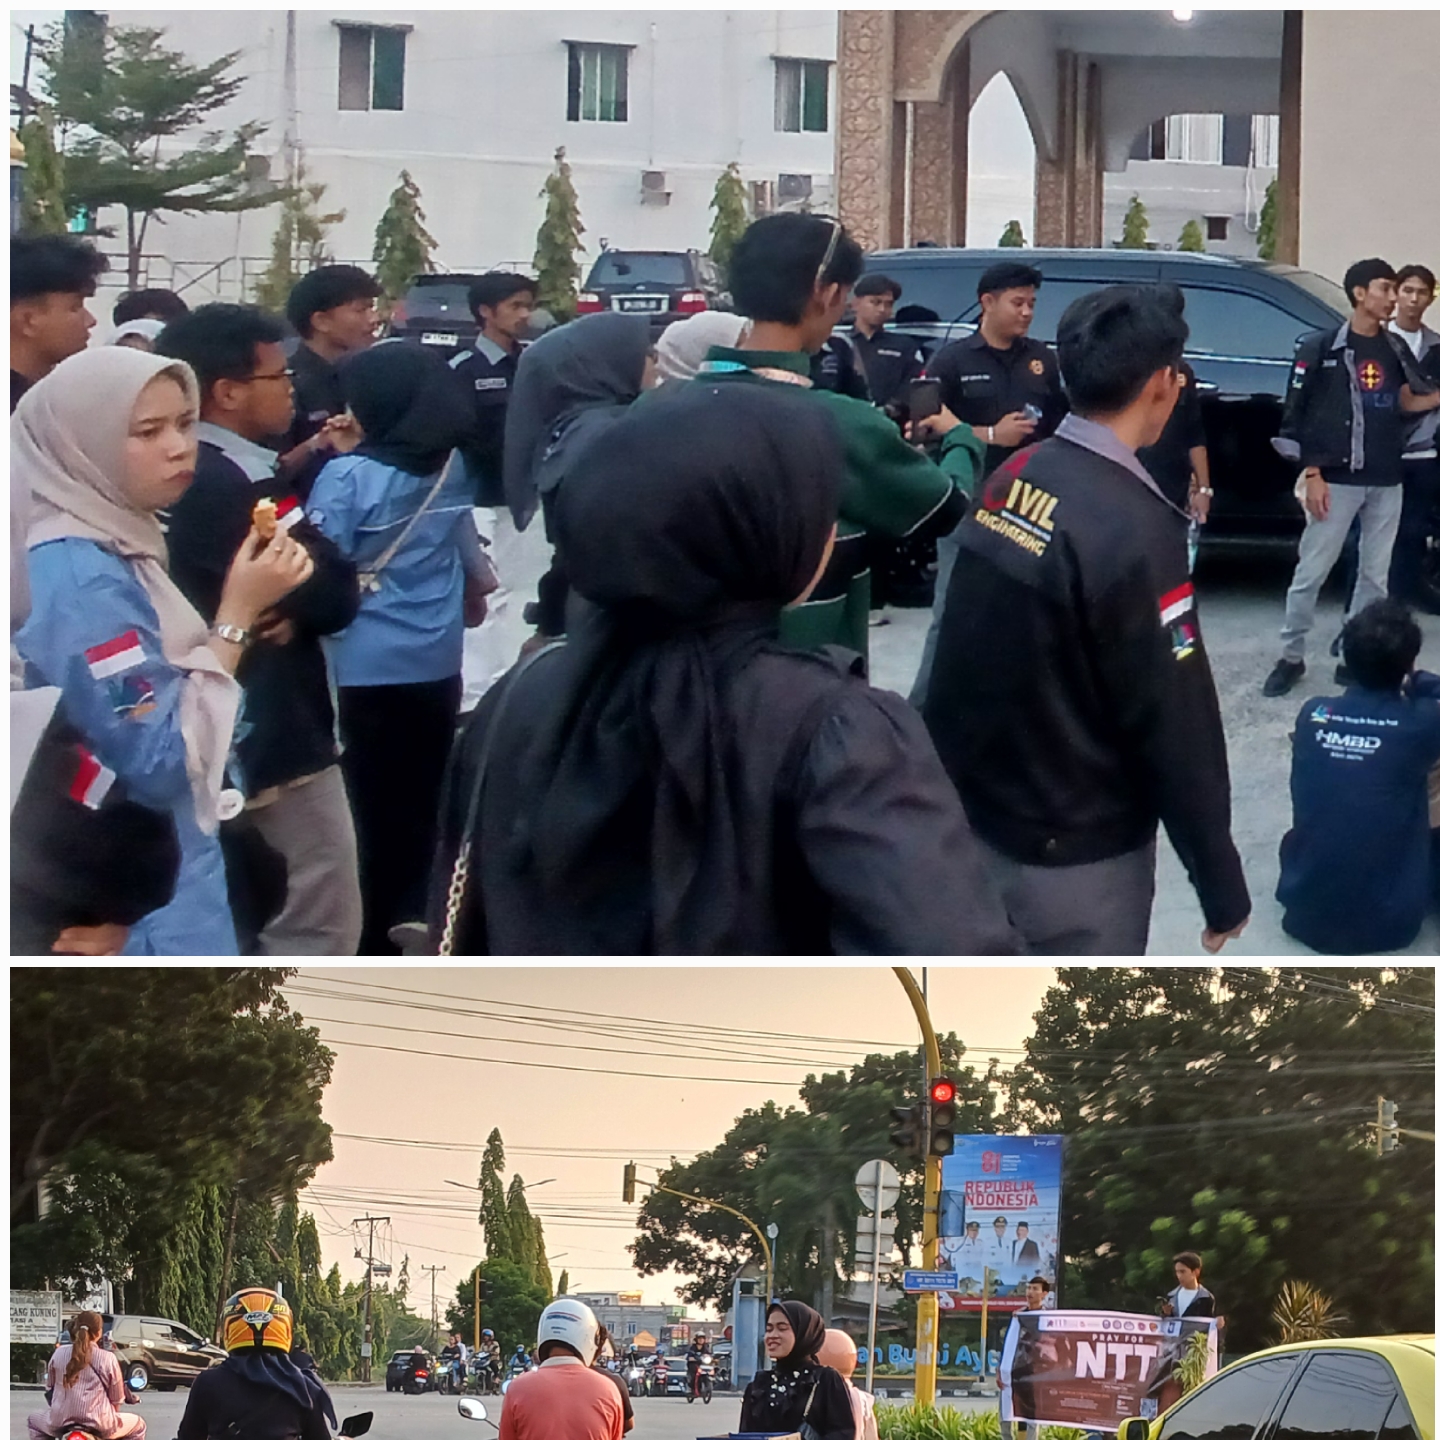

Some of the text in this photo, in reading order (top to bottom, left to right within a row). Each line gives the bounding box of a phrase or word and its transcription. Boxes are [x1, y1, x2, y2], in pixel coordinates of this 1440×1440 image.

[1315, 729, 1382, 750] HMBD
[965, 1181, 1035, 1193] REPUBLIK
[965, 1193, 1038, 1207] NDONESIA
[1092, 1334, 1144, 1344] PRAY FOR
[1075, 1341, 1157, 1382] NTT
